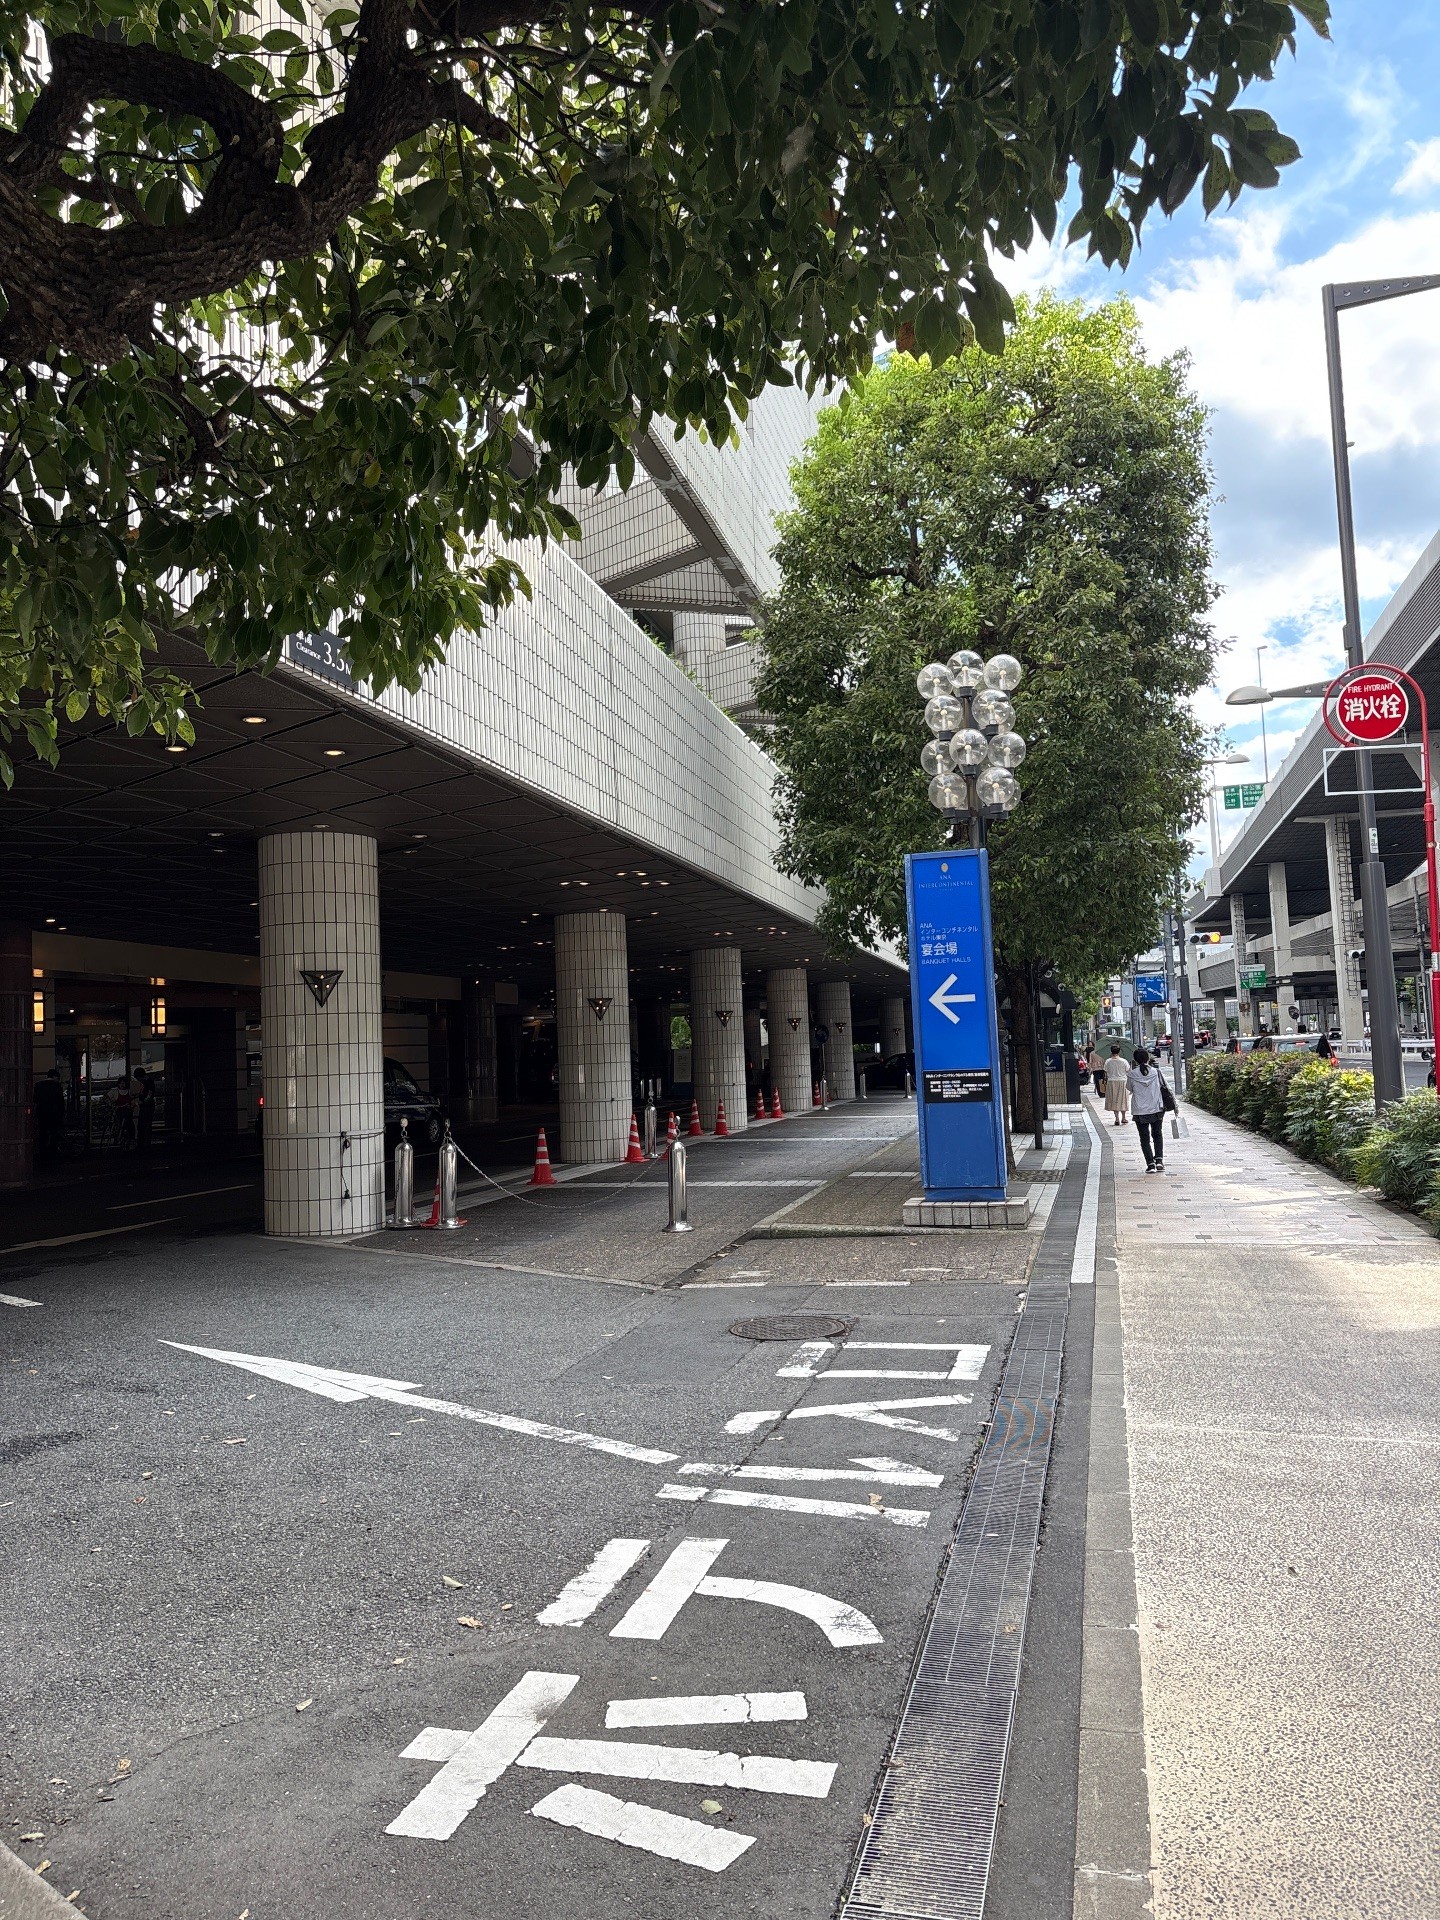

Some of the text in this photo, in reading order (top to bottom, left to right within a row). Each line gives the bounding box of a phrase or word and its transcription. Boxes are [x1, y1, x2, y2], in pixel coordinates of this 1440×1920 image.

[295, 641, 322, 661] Clearance
[1347, 683, 1393, 694] FIRE HYDRANT
[1343, 693, 1402, 723] 消火栓
[918, 881, 974, 889] INTERCONTINENTAL
[920, 926, 979, 935] インターコンチネンタル
[921, 941, 958, 957] 宴会場
[921, 957, 950, 965] BANQUET
